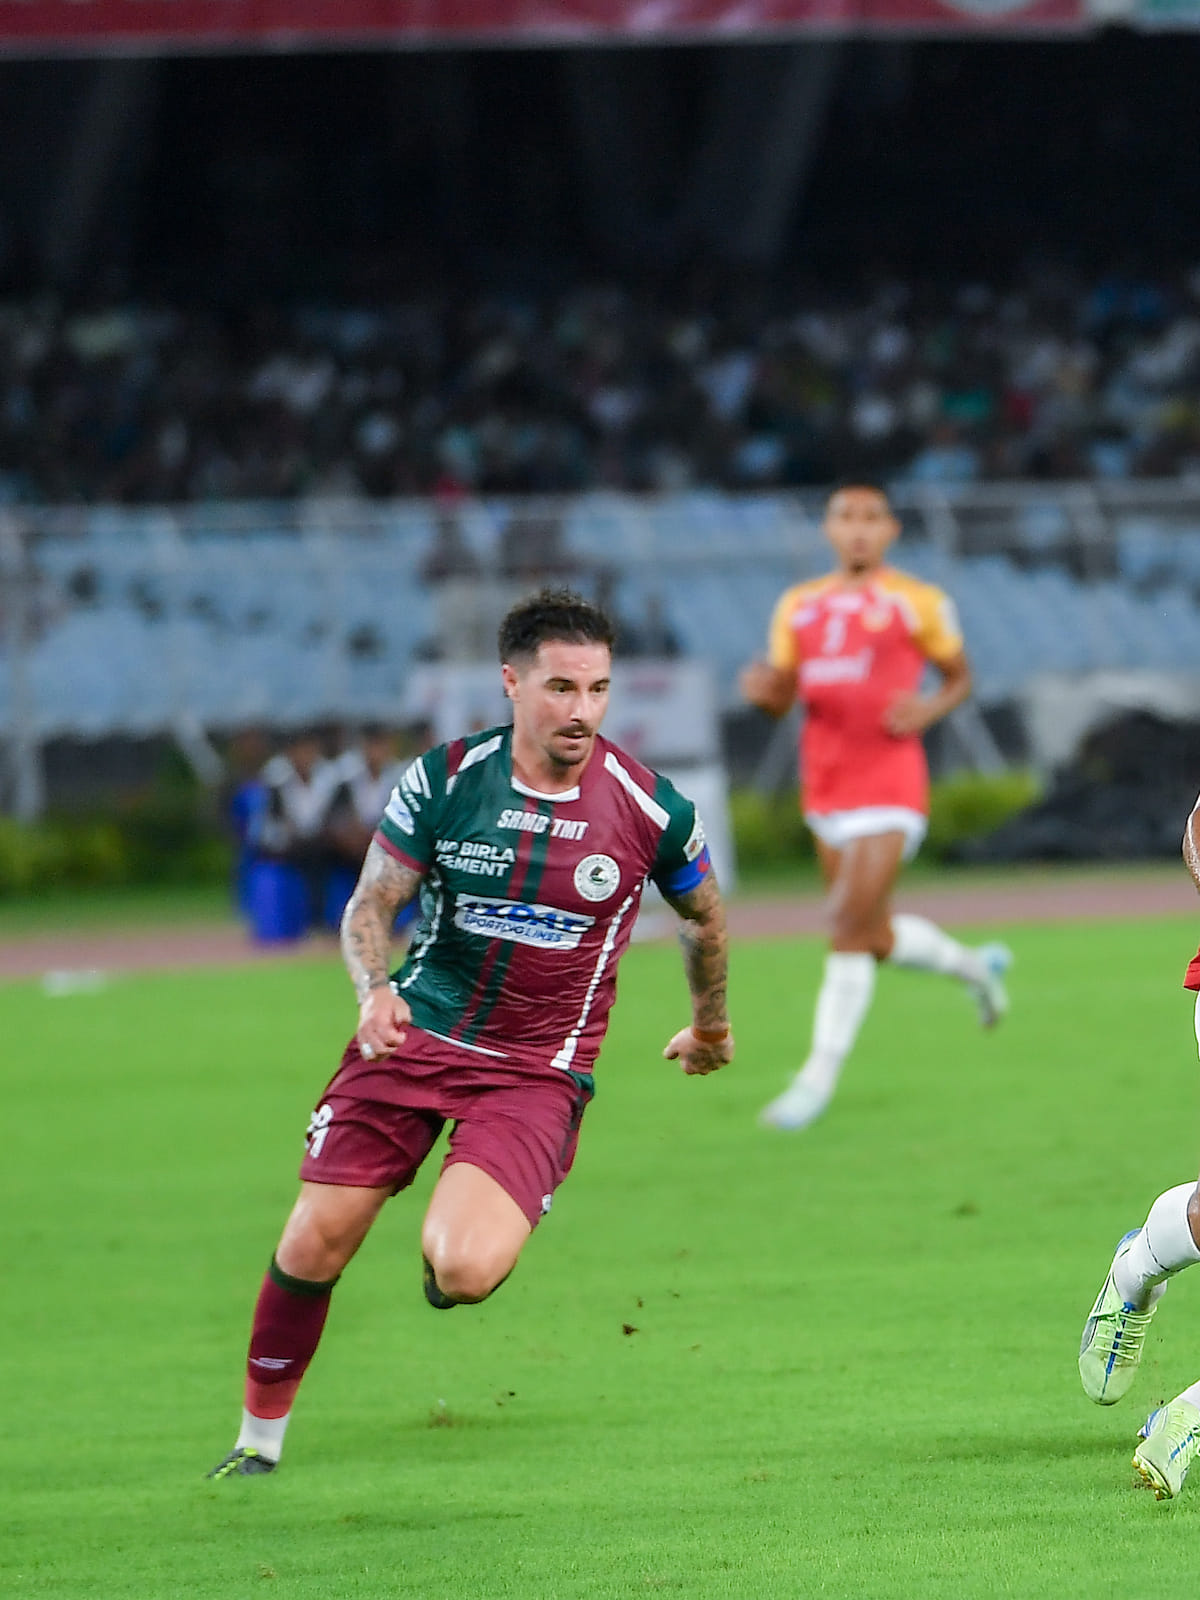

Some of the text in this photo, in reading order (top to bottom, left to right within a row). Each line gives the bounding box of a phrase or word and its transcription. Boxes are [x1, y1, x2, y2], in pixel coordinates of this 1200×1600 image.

[497, 809, 589, 841] SRMB TMT
[460, 841, 516, 863] BIRLA
